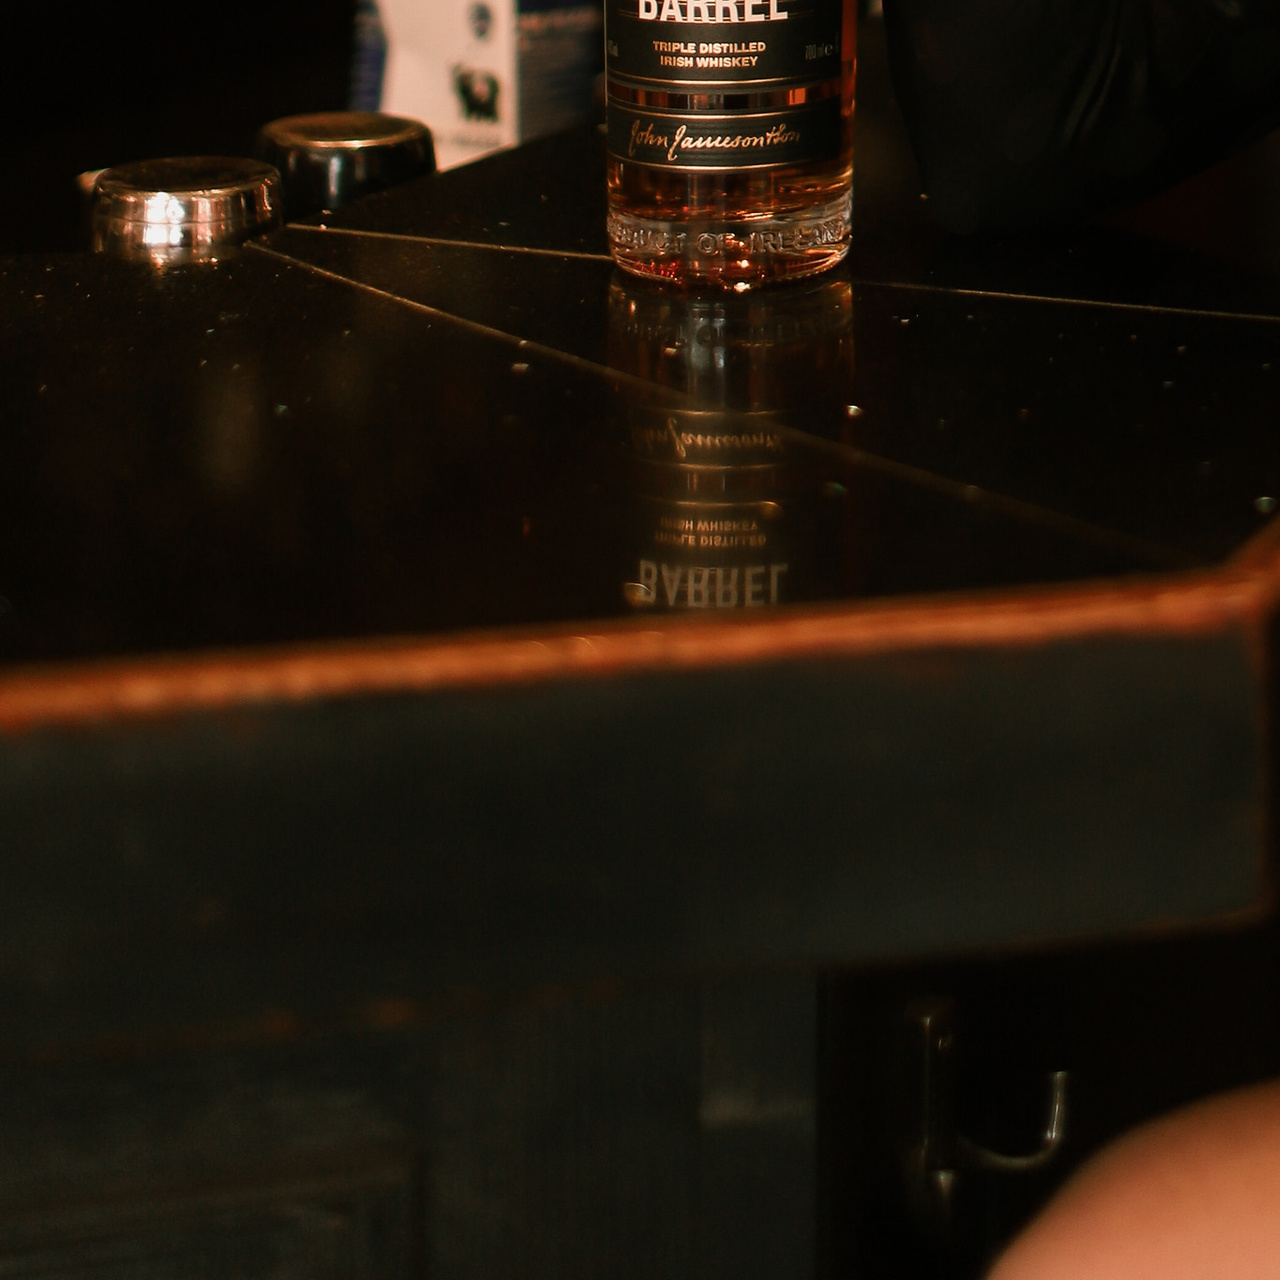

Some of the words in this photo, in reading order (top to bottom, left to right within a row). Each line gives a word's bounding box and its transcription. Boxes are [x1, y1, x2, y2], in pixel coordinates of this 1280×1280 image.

[652, 40, 697, 54] TRIPLE
[699, 41, 767, 55] DISTILLED
[659, 56, 694, 68] IRISH
[696, 56, 759, 68] WHISKEY
